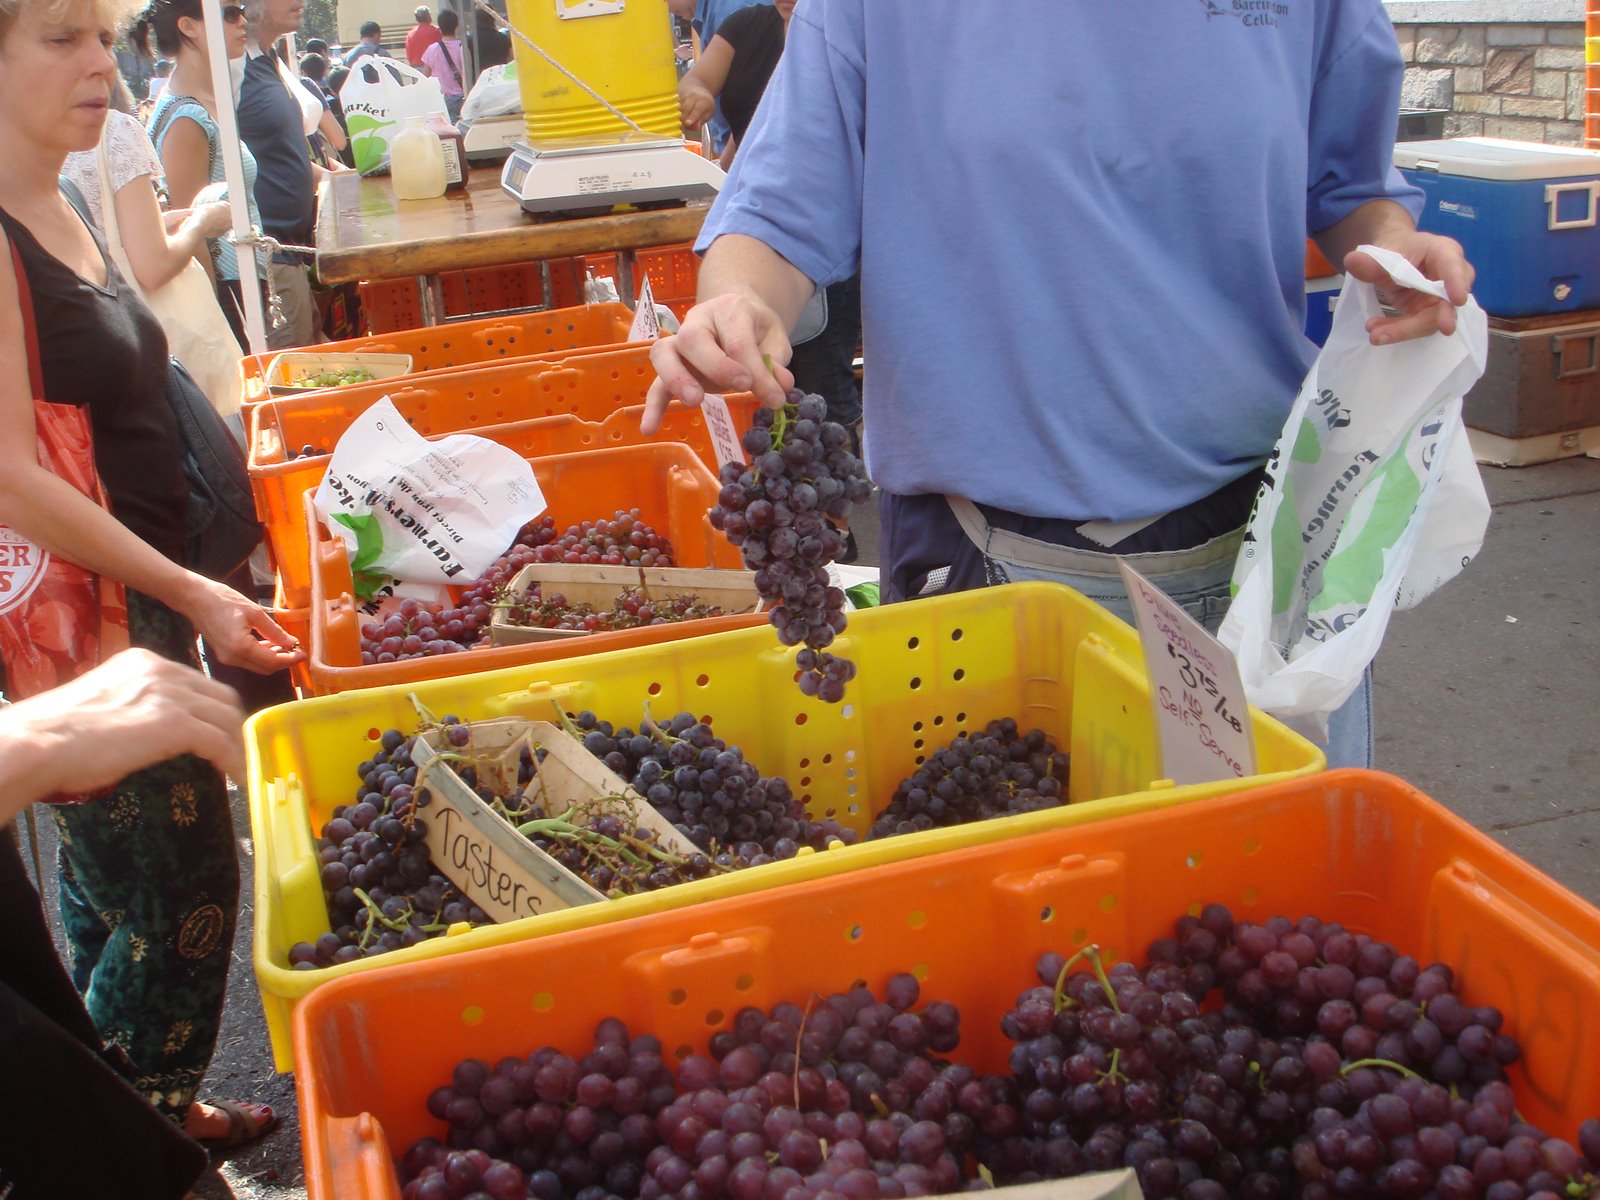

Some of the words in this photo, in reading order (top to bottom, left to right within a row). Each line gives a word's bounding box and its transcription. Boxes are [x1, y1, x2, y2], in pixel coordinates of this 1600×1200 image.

[346, 473, 369, 489] you
[384, 499, 464, 578] Farmers
[432, 511, 464, 544] Direct
[435, 807, 542, 919] Tasters
